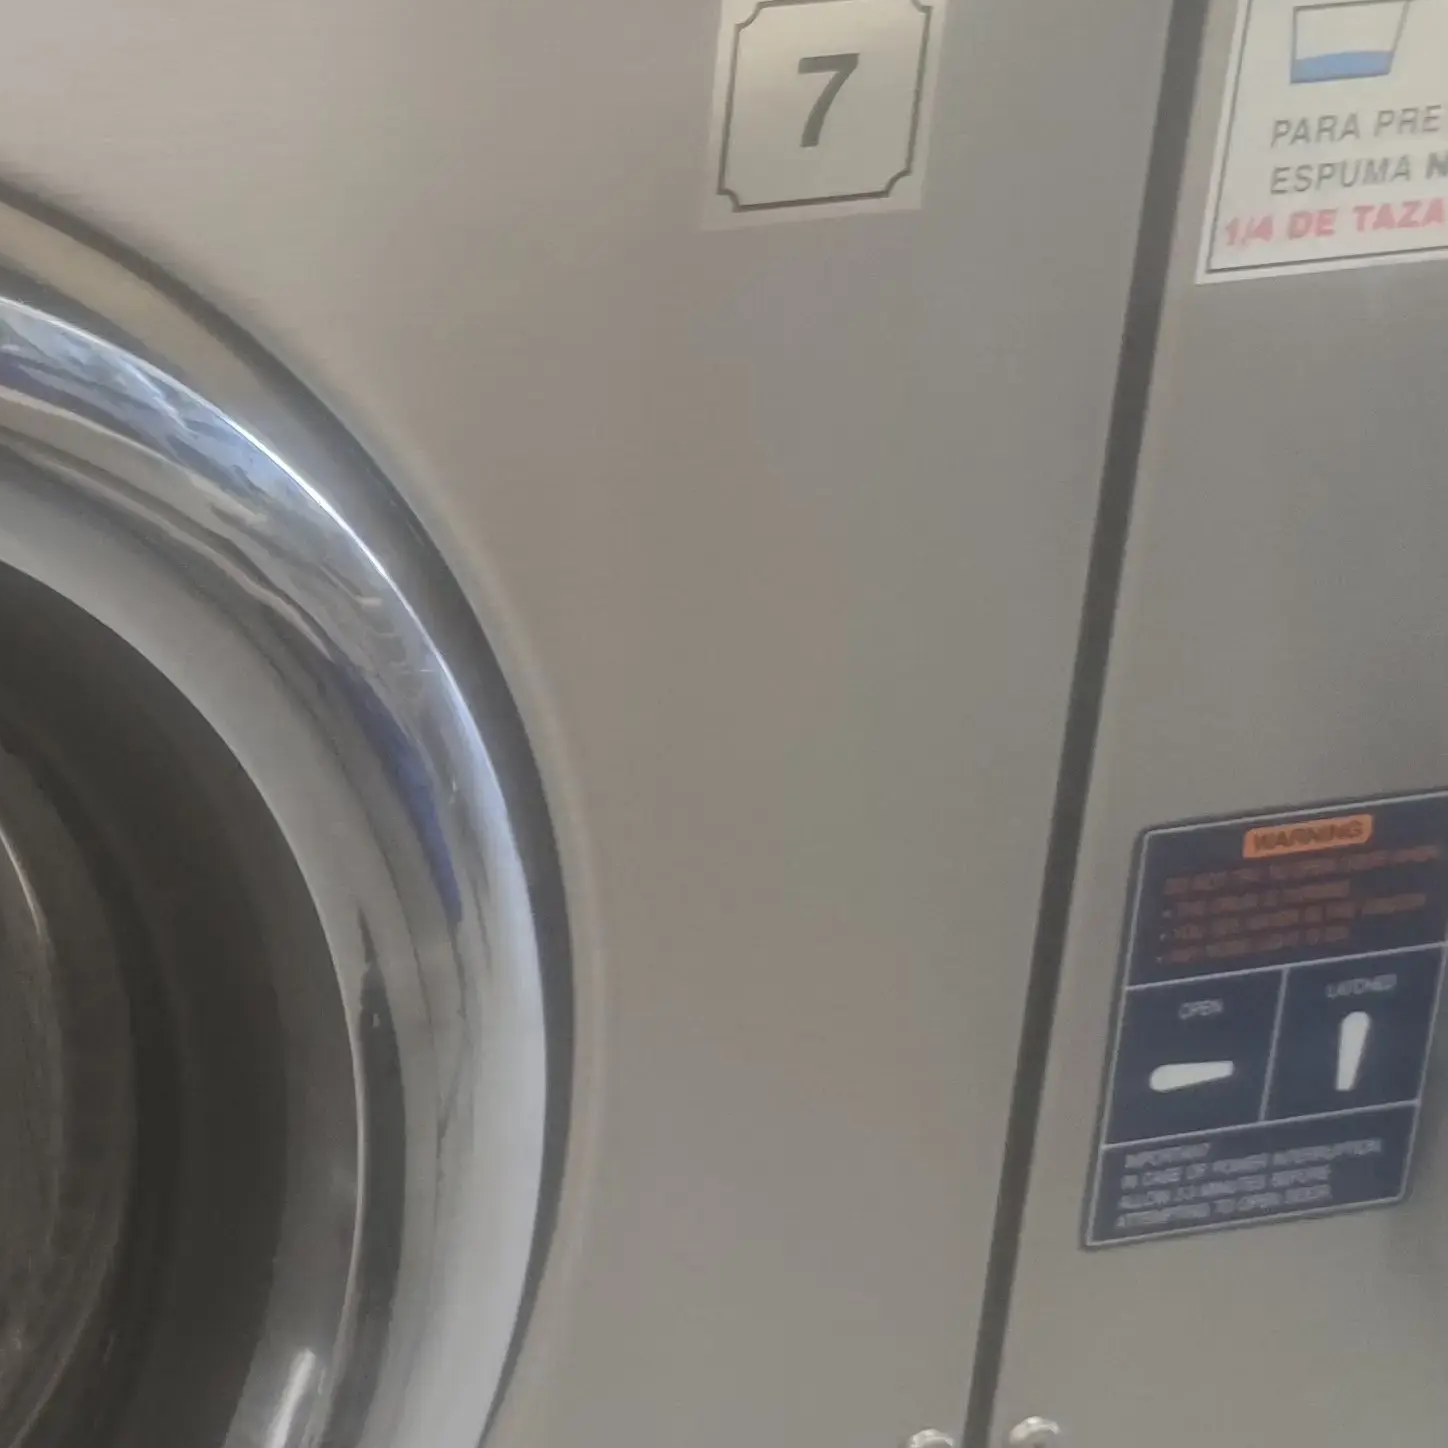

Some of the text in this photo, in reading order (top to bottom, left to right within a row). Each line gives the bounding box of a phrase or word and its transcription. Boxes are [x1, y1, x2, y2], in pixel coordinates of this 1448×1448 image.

[796, 51, 861, 148] 7
[1270, 104, 1443, 148] PARA PRE
[1270, 156, 1412, 195] ESPUMA
[1224, 196, 1446, 248] 1/4 DE TAZA
